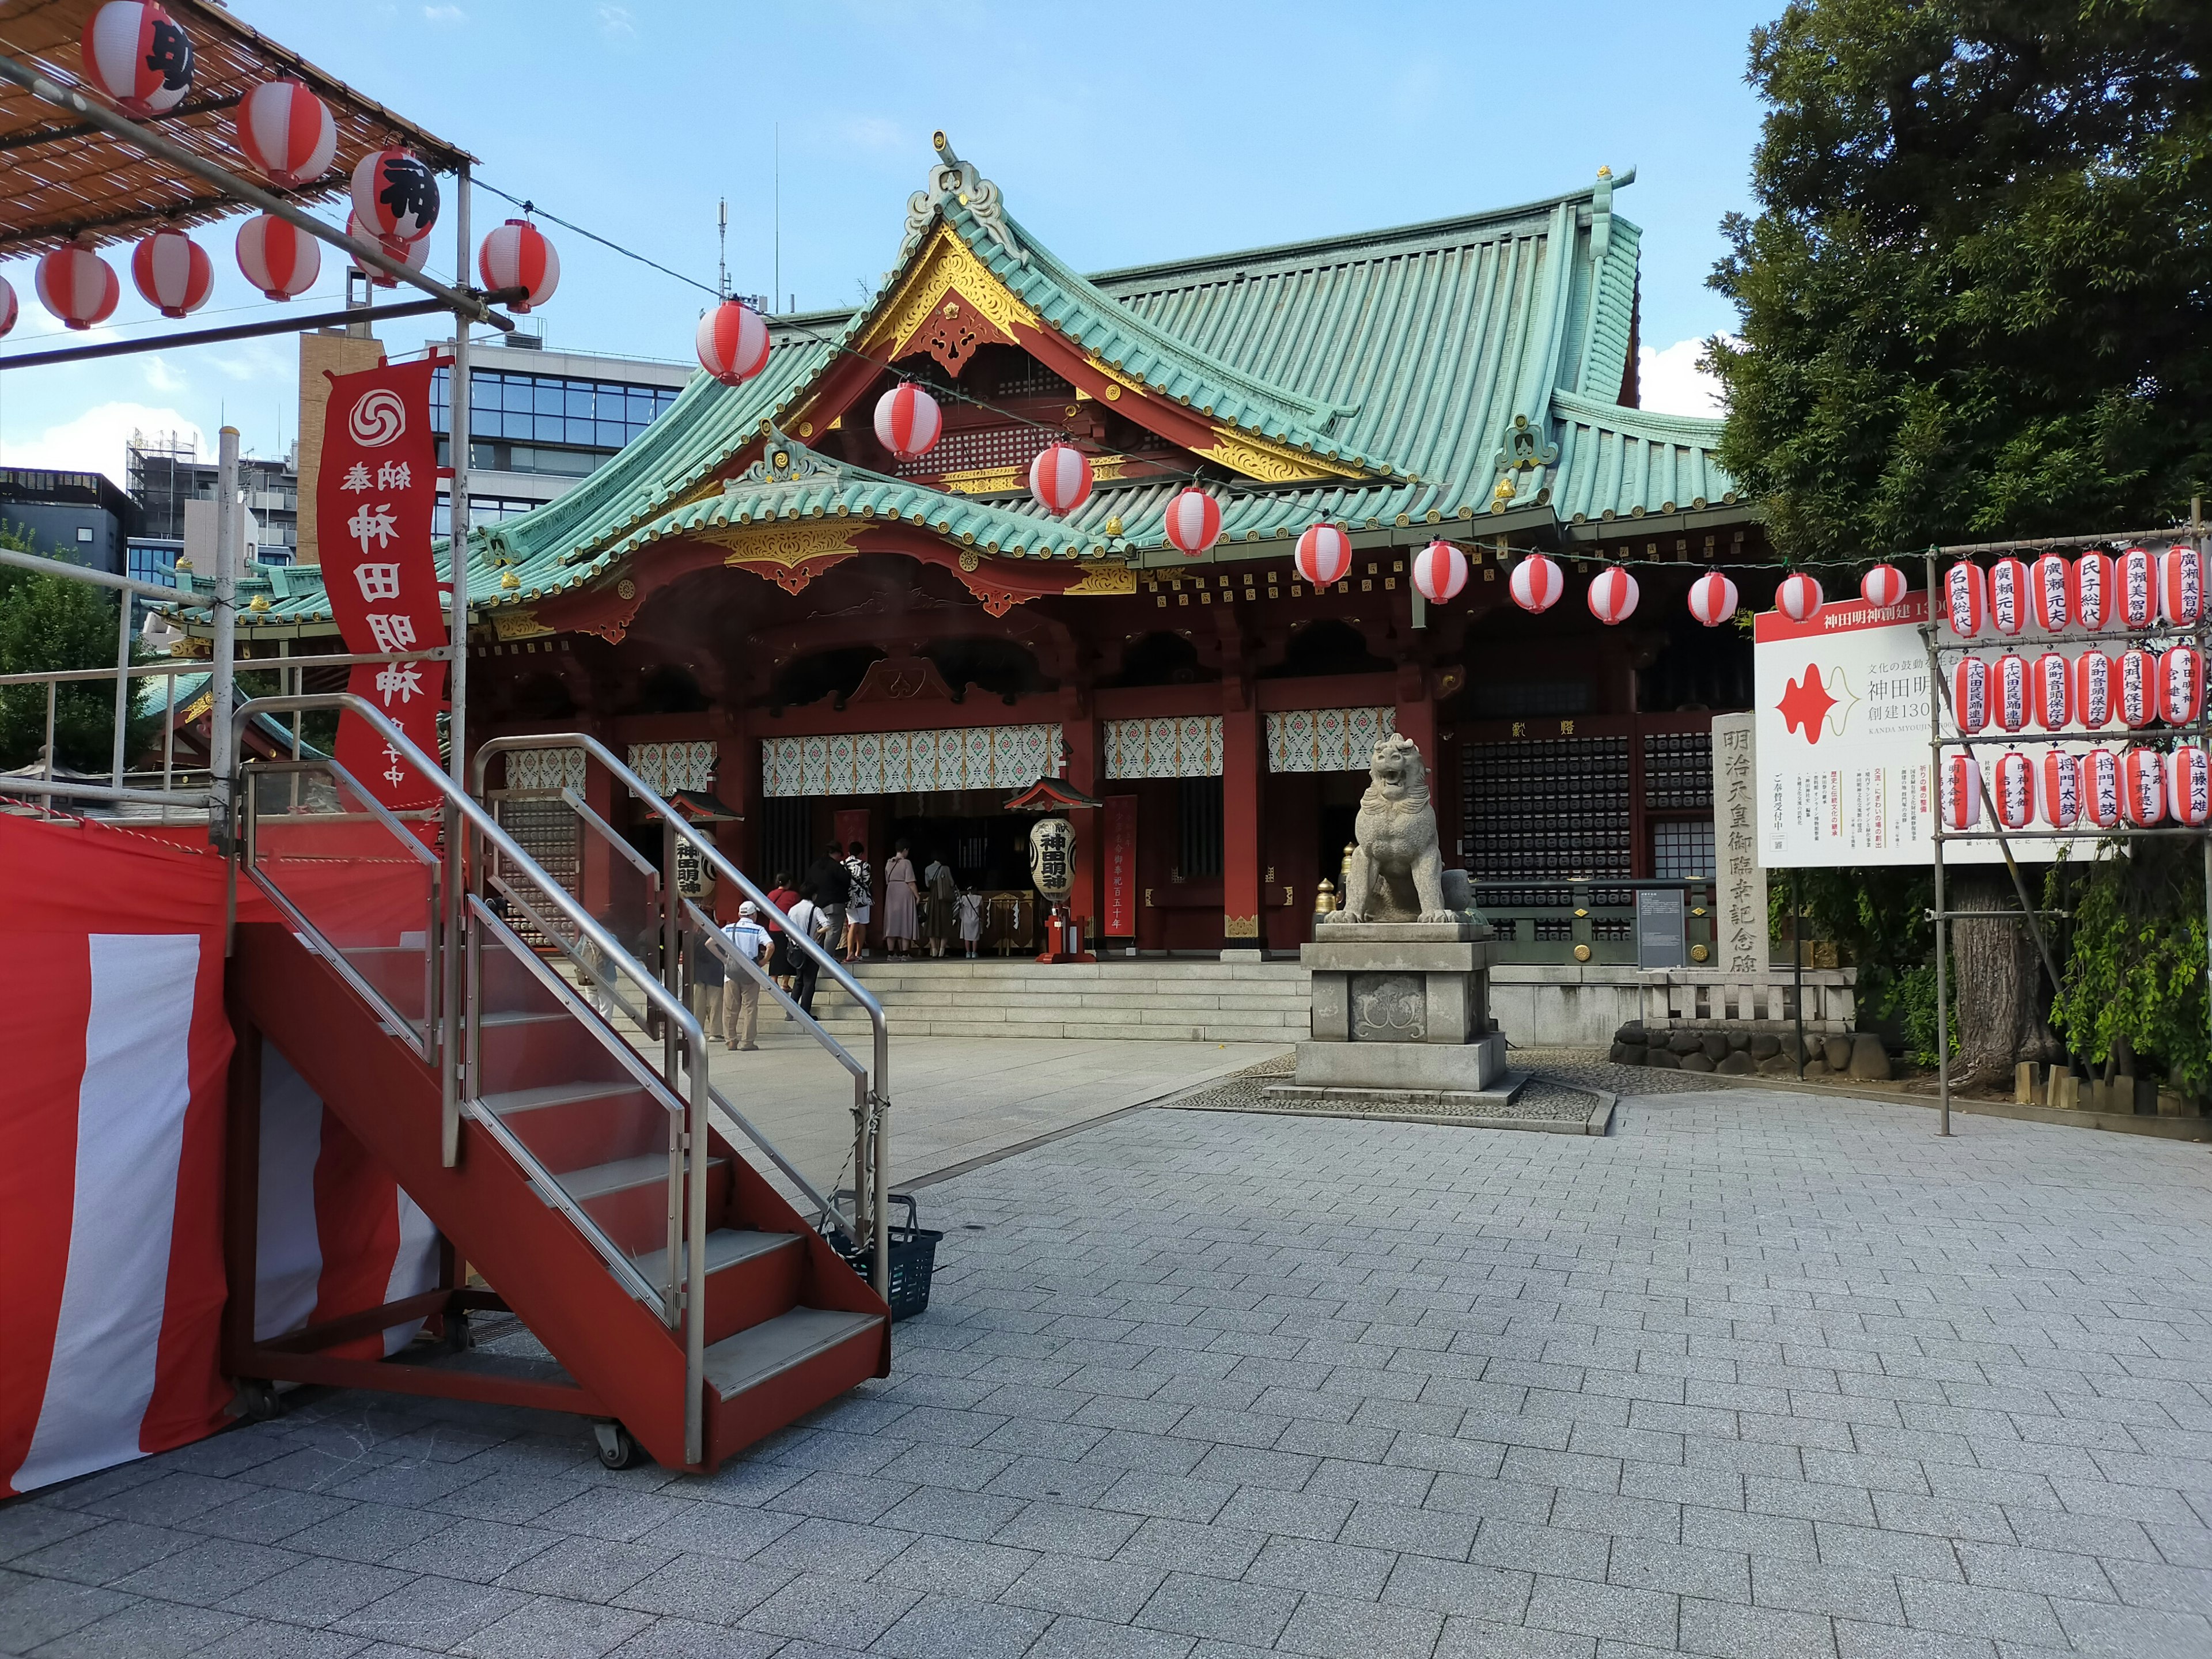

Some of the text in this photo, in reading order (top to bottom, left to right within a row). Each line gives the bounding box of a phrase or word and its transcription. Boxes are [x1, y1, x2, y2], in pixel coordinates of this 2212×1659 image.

[1824, 605, 1911, 630] 神田明神創建
[1950, 570, 1972, 628] 名誉総代
[2081, 560, 2101, 622] 氏子総代
[1967, 663, 1983, 727] 千代田区民踊連盟
[2005, 662, 2021, 727] 千代田区民踊連盟
[2047, 660, 2064, 726] 浜町音頭保存会
[2088, 658, 2107, 724] 浜町音頭保存会
[2181, 655, 2195, 703] 神田明神
[1869, 726, 1896, 735] KANDA
[1774, 773, 1783, 831] ご奉賛受付中
[1947, 764, 1960, 806] 明神会館
[2015, 763, 2031, 807] 明神会館
[2058, 757, 2077, 815] 将門太鼓
[2096, 757, 2117, 816] 将門太鼓
[2190, 754, 2207, 812] 遠藤久雄
[677, 843, 701, 893] 神田明神
[1040, 834, 1067, 889] 神田明神
[1723, 729, 1757, 972] 明治天皇御臨幸記念碑
